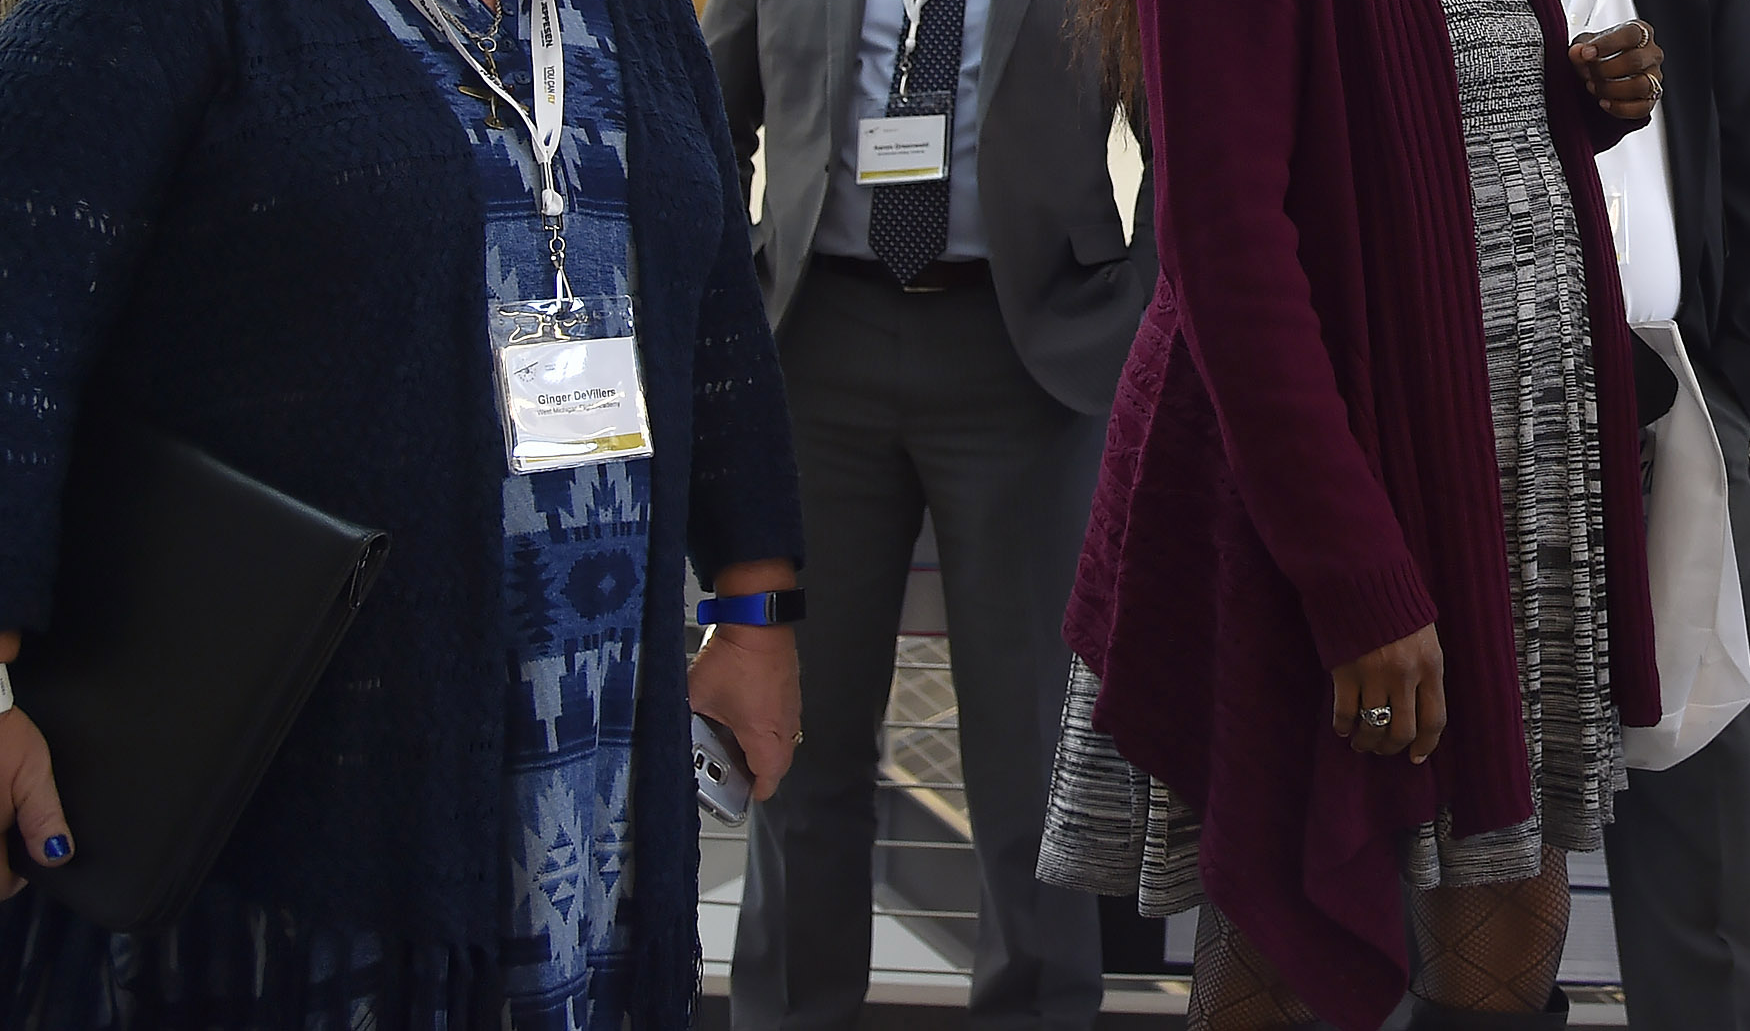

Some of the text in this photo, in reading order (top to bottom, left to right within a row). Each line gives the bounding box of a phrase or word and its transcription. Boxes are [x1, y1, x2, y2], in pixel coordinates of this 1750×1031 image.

[541, 1, 553, 48] JEPPESEN
[538, 388, 617, 406] Ginger DeVillers
